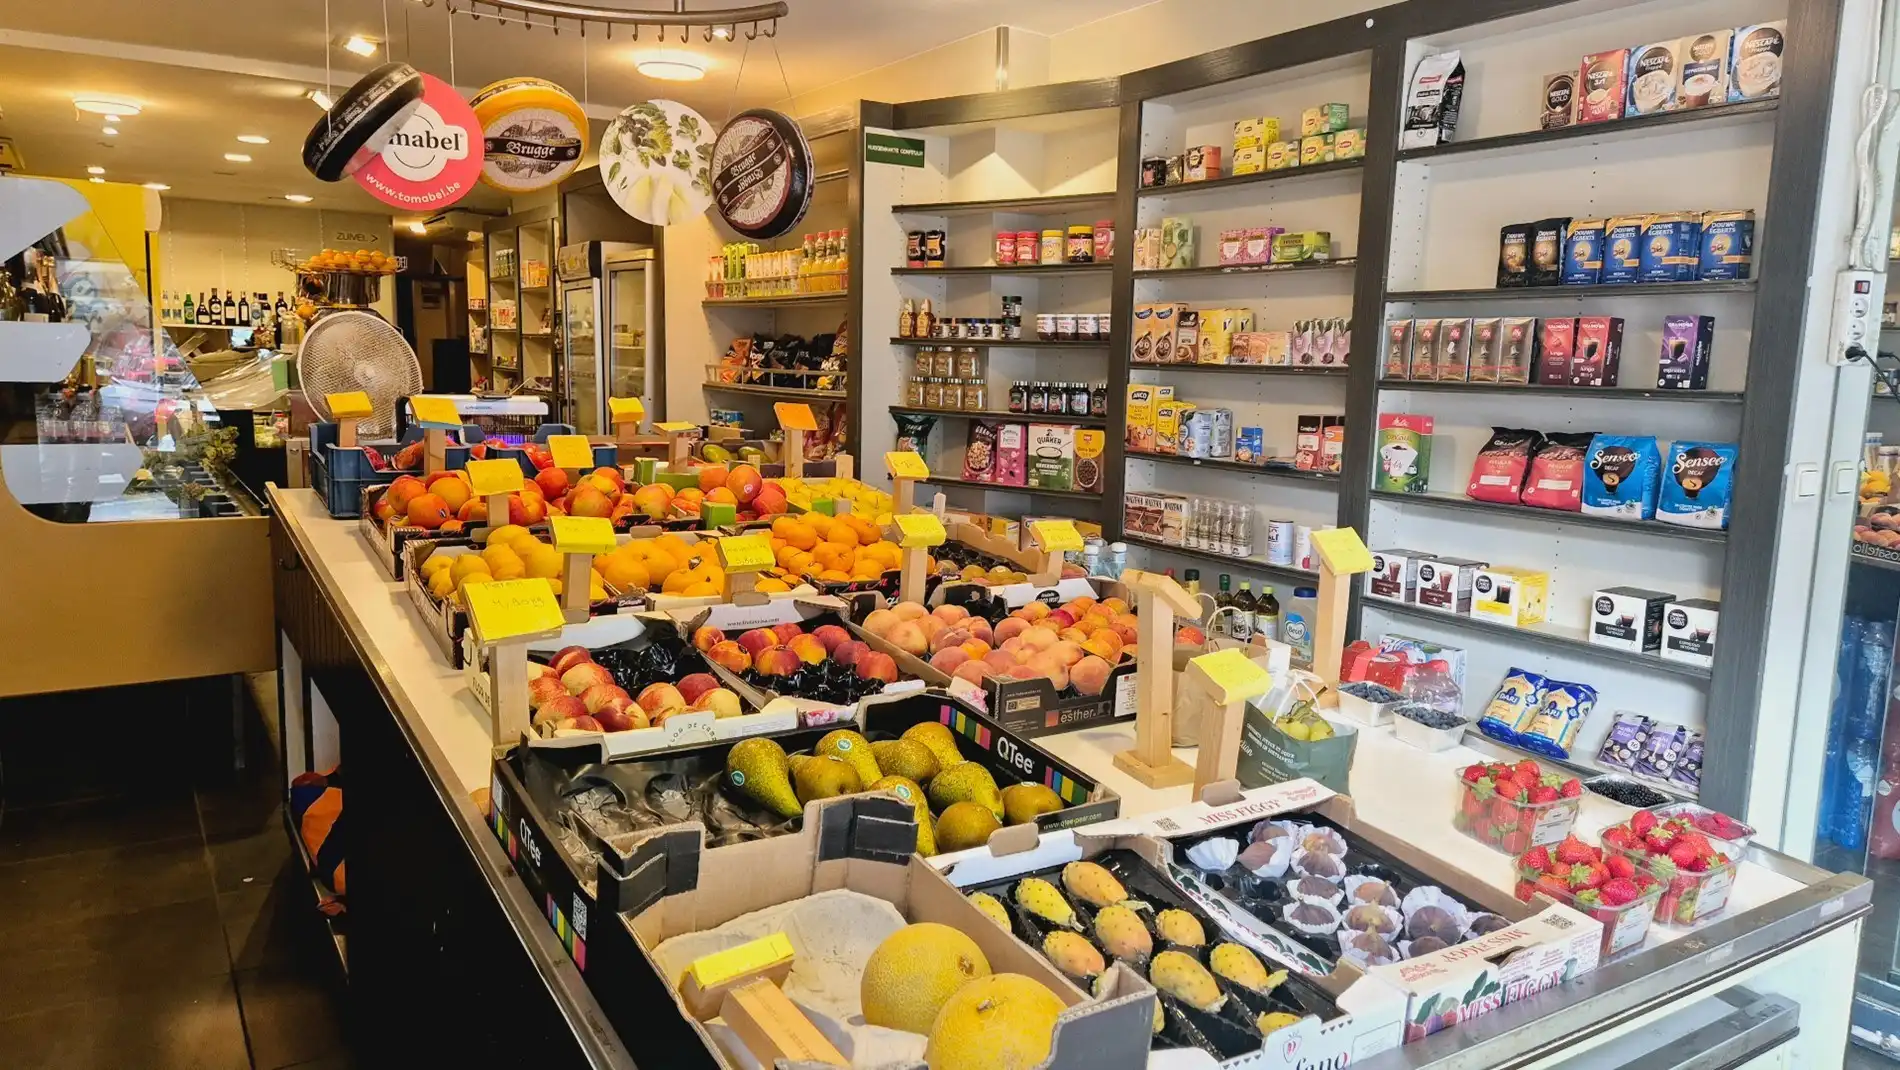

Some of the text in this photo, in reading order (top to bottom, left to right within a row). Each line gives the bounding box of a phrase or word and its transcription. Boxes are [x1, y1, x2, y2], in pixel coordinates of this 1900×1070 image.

[389, 130, 460, 151] mabel
[506, 141, 556, 159] Brugge
[730, 151, 757, 178] Brugge
[366, 172, 461, 204] www.tomabel.be
[737, 169, 764, 192] Brugge
[336, 232, 369, 241] ZUIVEL
[1037, 436, 1062, 445] QUAKER
[1590, 449, 1642, 469] Senseo
[1672, 452, 1728, 474] Senseo
[1288, 626, 1303, 635] Becel
[1500, 692, 1518, 704] DARI
[997, 736, 1033, 775] QTee
[1043, 812, 1103, 831] www.qtee-pear.com
[1198, 799, 1282, 827] MISS FIGGY
[520, 818, 543, 868] QTee
[1457, 970, 1560, 1019] MISS FIGGY
